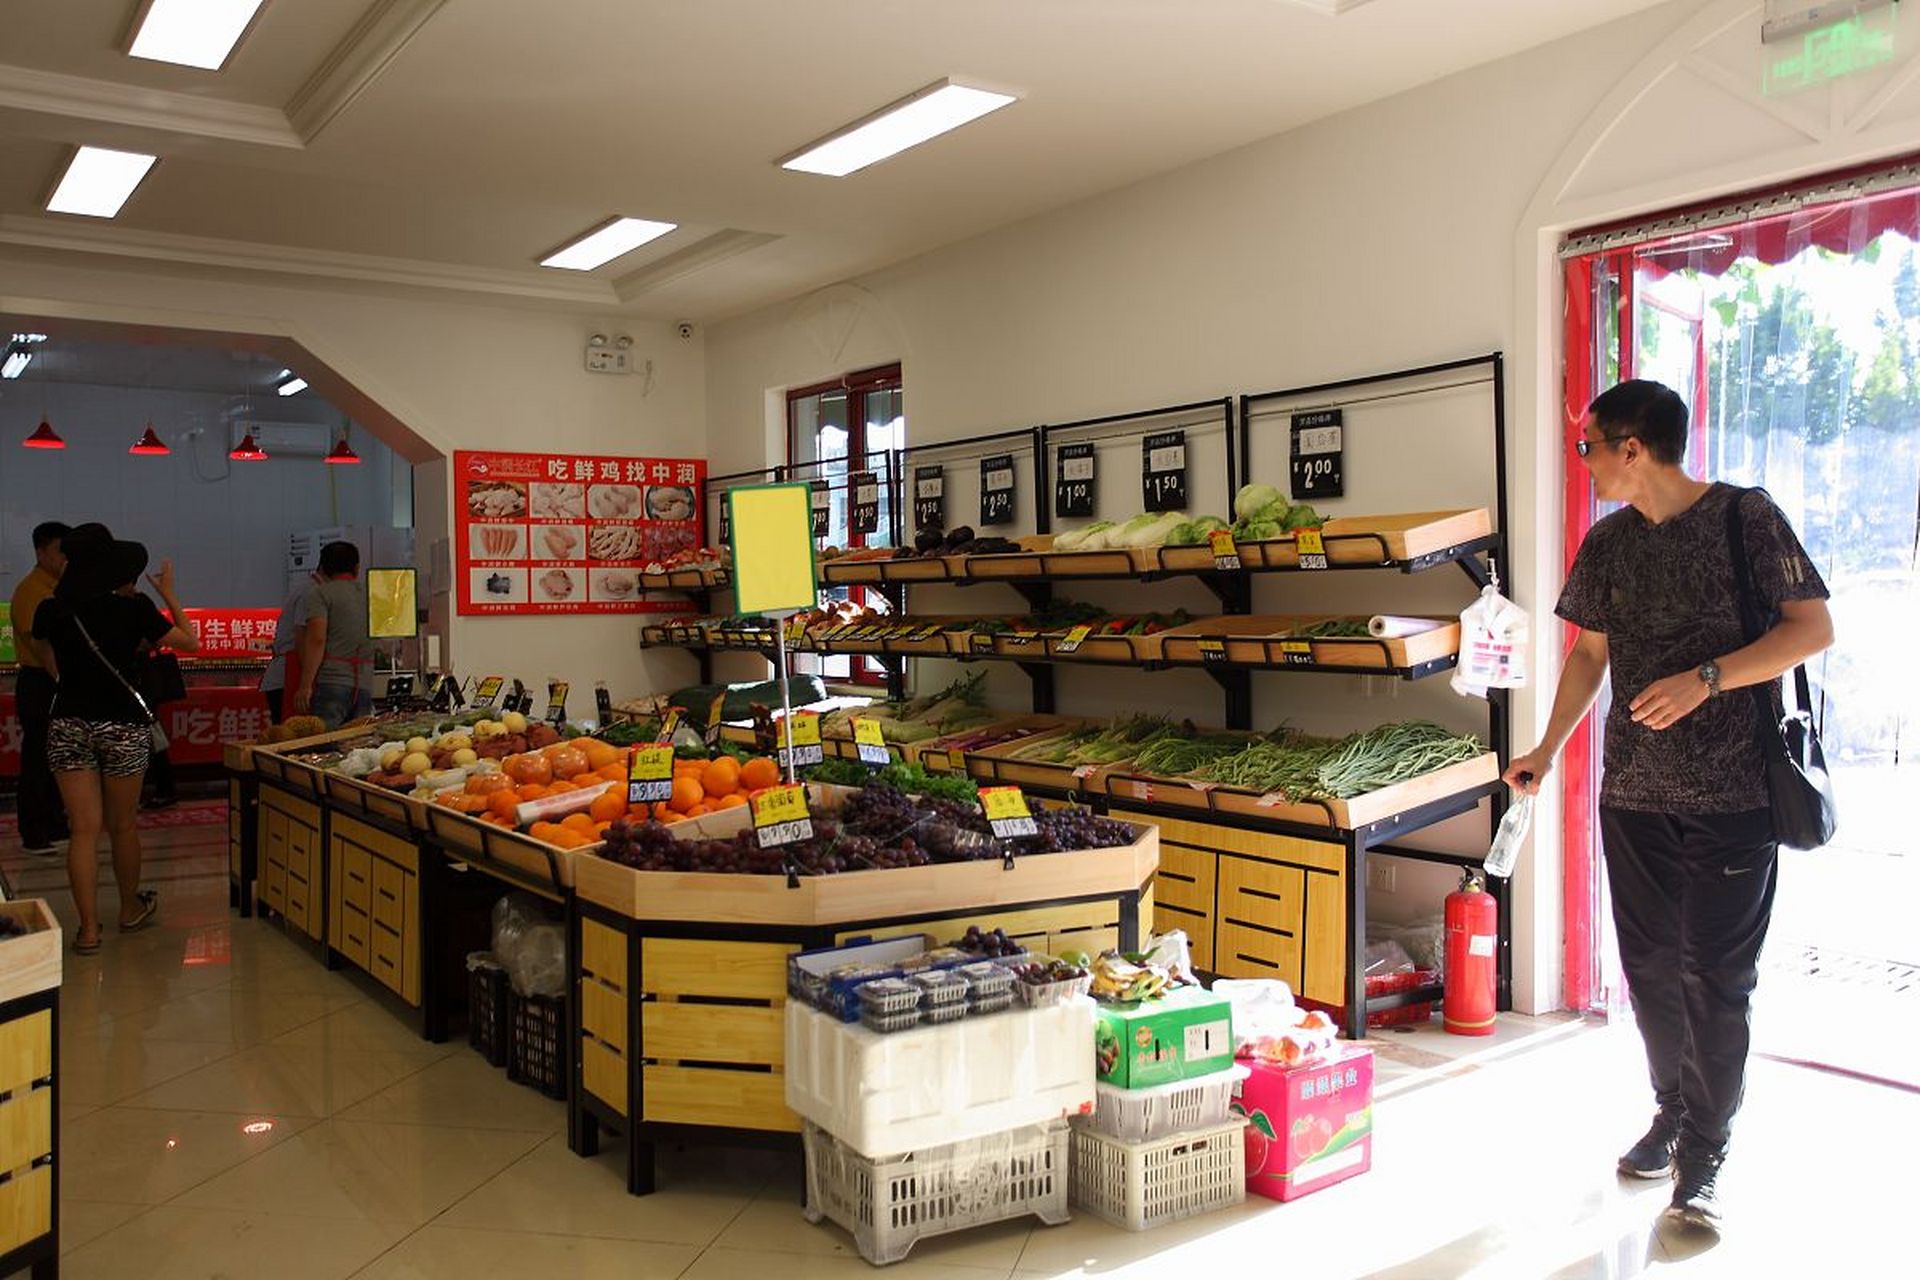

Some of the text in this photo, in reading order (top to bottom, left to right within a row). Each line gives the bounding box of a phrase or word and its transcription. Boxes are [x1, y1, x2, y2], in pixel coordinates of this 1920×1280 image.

[547, 459, 697, 484] 吃鲜鸡找中润
[171, 705, 272, 745] 吃鲜
